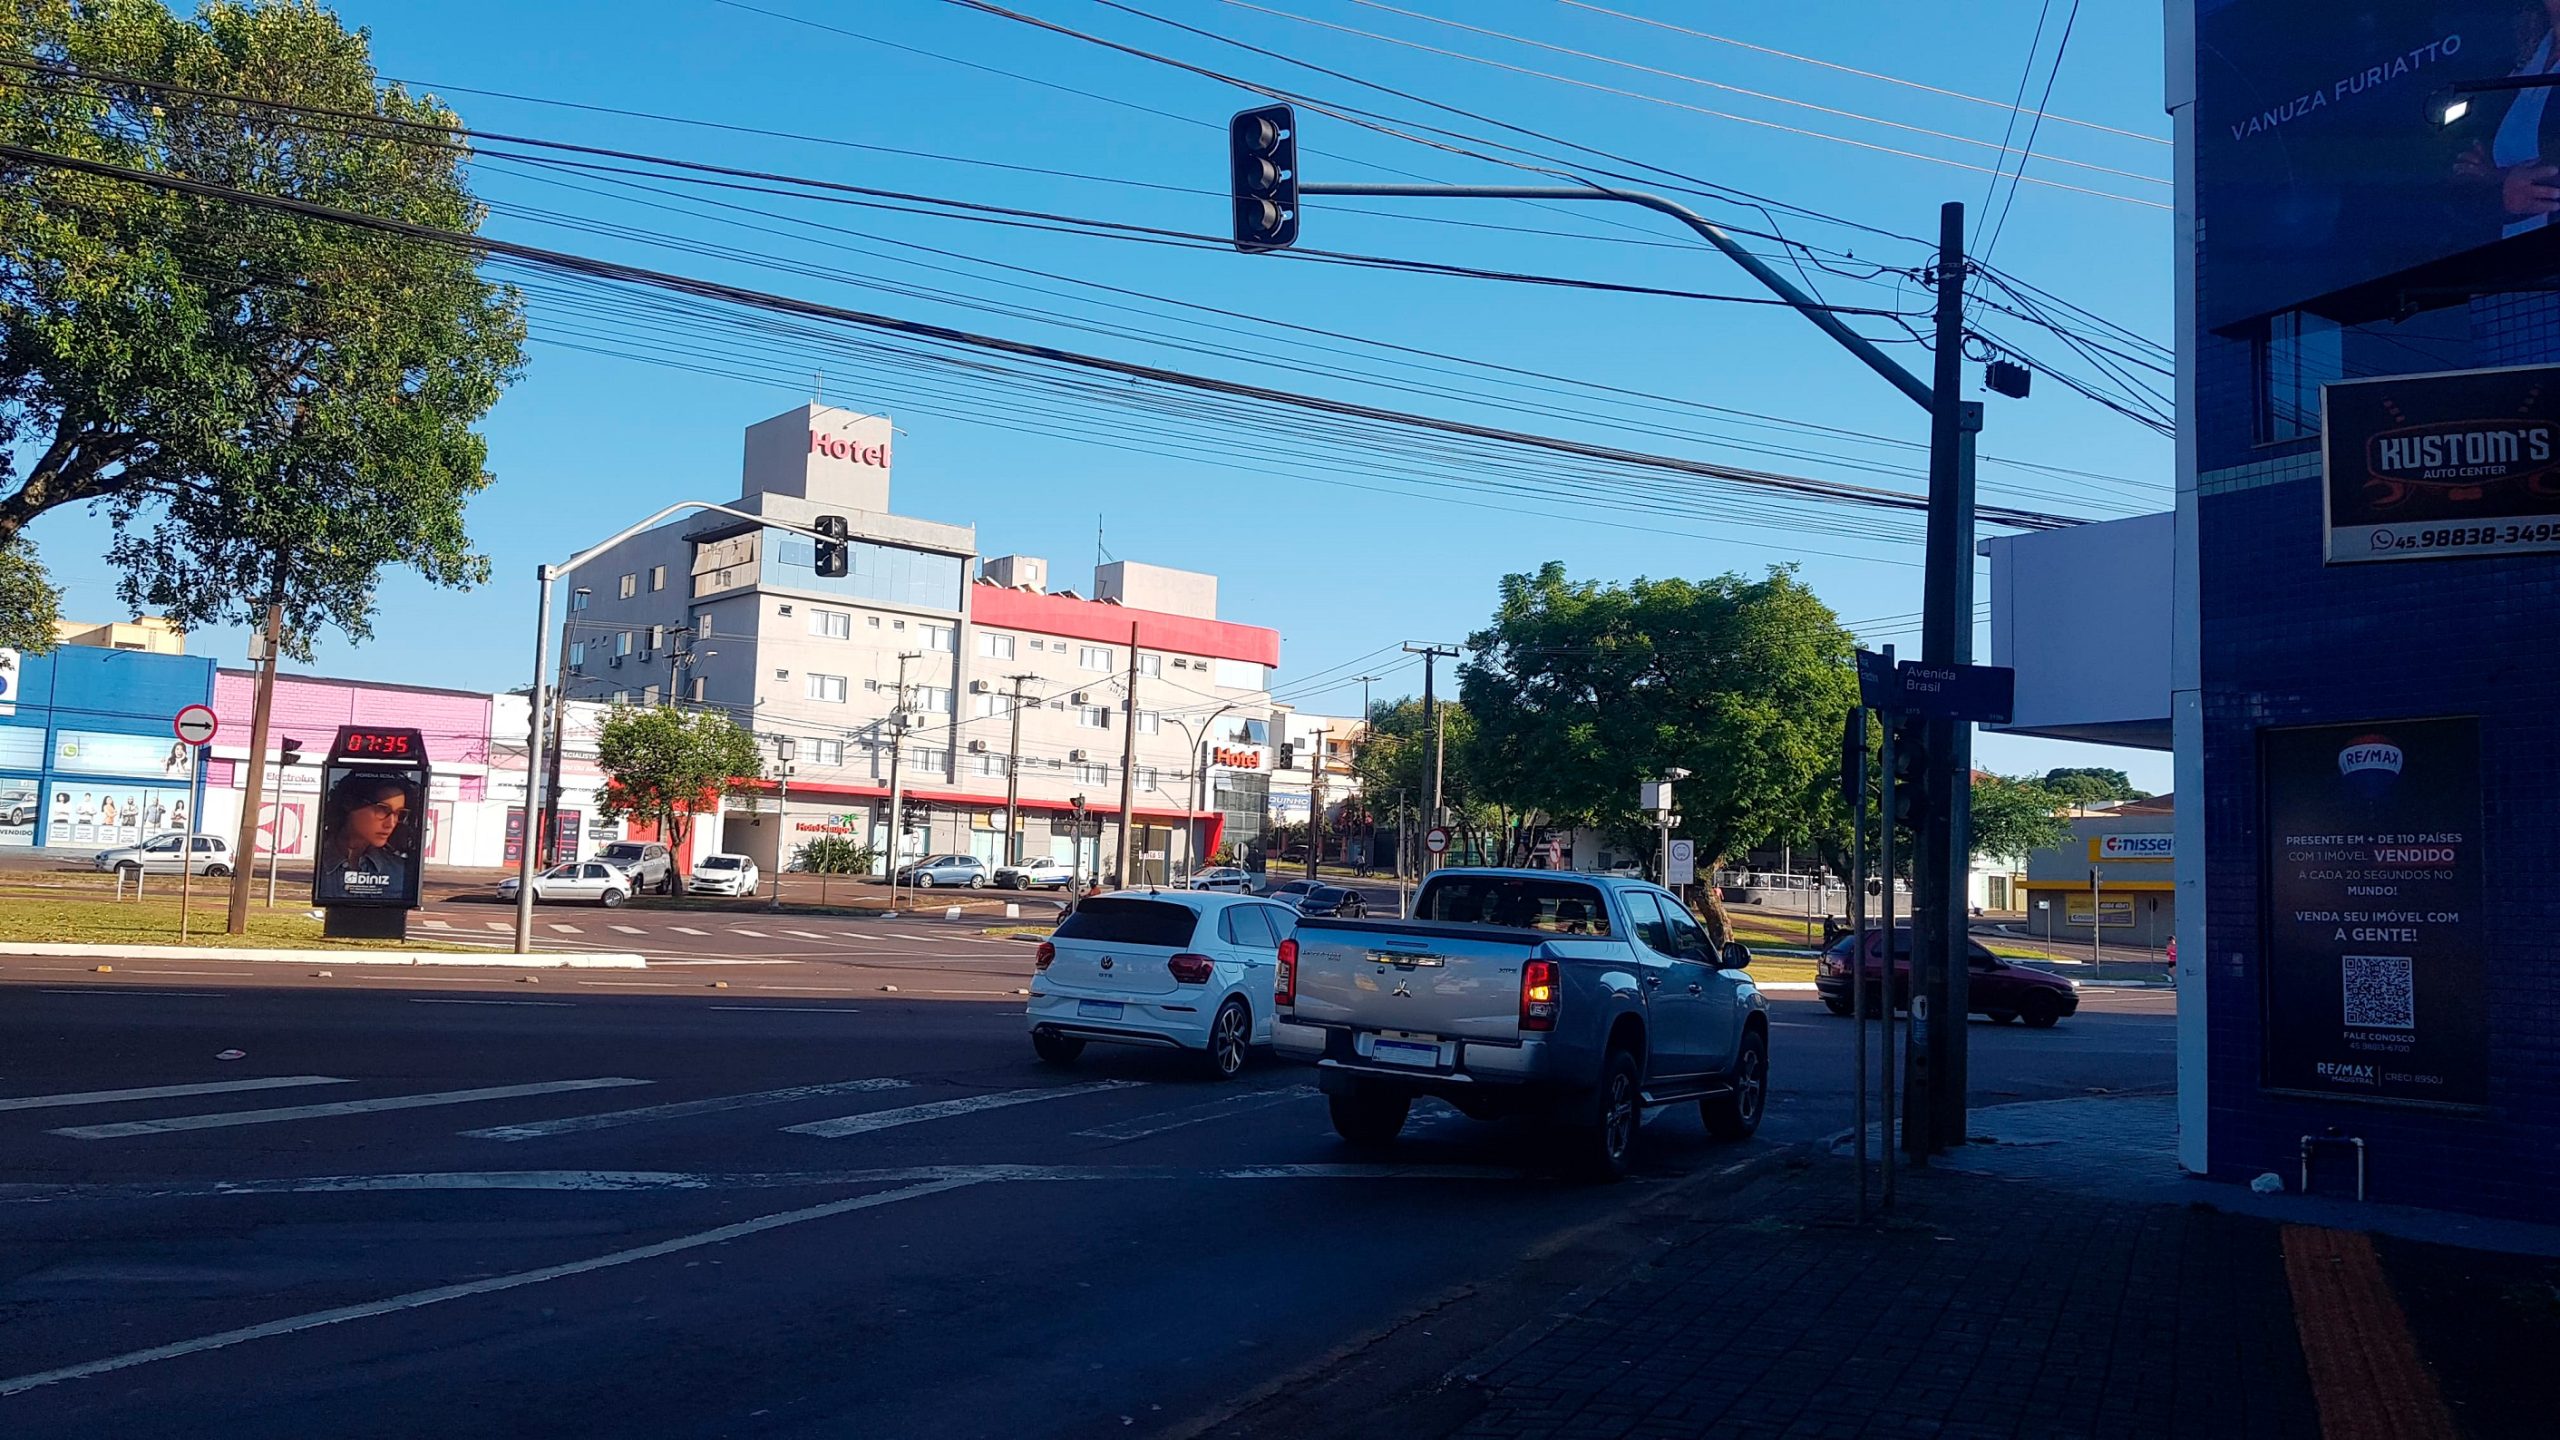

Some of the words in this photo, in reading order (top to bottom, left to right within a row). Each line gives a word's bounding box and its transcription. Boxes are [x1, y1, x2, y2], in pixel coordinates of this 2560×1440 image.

[2231, 90, 2327, 141] VANUZA
[2335, 34, 2462, 101] FURIATTO
[809, 430, 892, 468] Hotel
[2423, 468, 2456, 479] AUTO
[2460, 466, 2507, 477] CENTER
[1907, 666, 1956, 681] Avenida
[1906, 679, 1941, 693] Brasil
[347, 735, 408, 752] 07:35
[1213, 747, 1260, 769] Hotel
[2346, 750, 2399, 766] RE/MAX
[2286, 836, 2344, 845] PRESENTE
[2347, 835, 2364, 844] EM
[2378, 835, 2394, 844] DE
[2397, 834, 2415, 843] 110
[2419, 832, 2463, 843] PAÍSES
[2289, 851, 2314, 861] COM
[2325, 849, 2368, 861] IMÓVEL
[2374, 849, 2455, 862] VENDIDO
[2299, 871, 2307, 880] A
[2309, 871, 2342, 880] CADA
[2346, 871, 2361, 880] 20
[2364, 870, 2431, 880] SEGUNDOS
[2434, 870, 2454, 880] NO
[2347, 886, 2398, 896] MUNDO!
[2296, 911, 2340, 922] VENDA
[2343, 911, 2368, 922] SEU
[2373, 909, 2424, 923] IMÓVEL
[2427, 912, 2459, 923] COM
[2334, 927, 2347, 941] A
[2352, 927, 2417, 942] GENTE!
[2343, 1031, 2366, 1040] FALE
[2368, 1032, 2415, 1043] CONOSCO
[2317, 1062, 2374, 1078] RE/MAX
